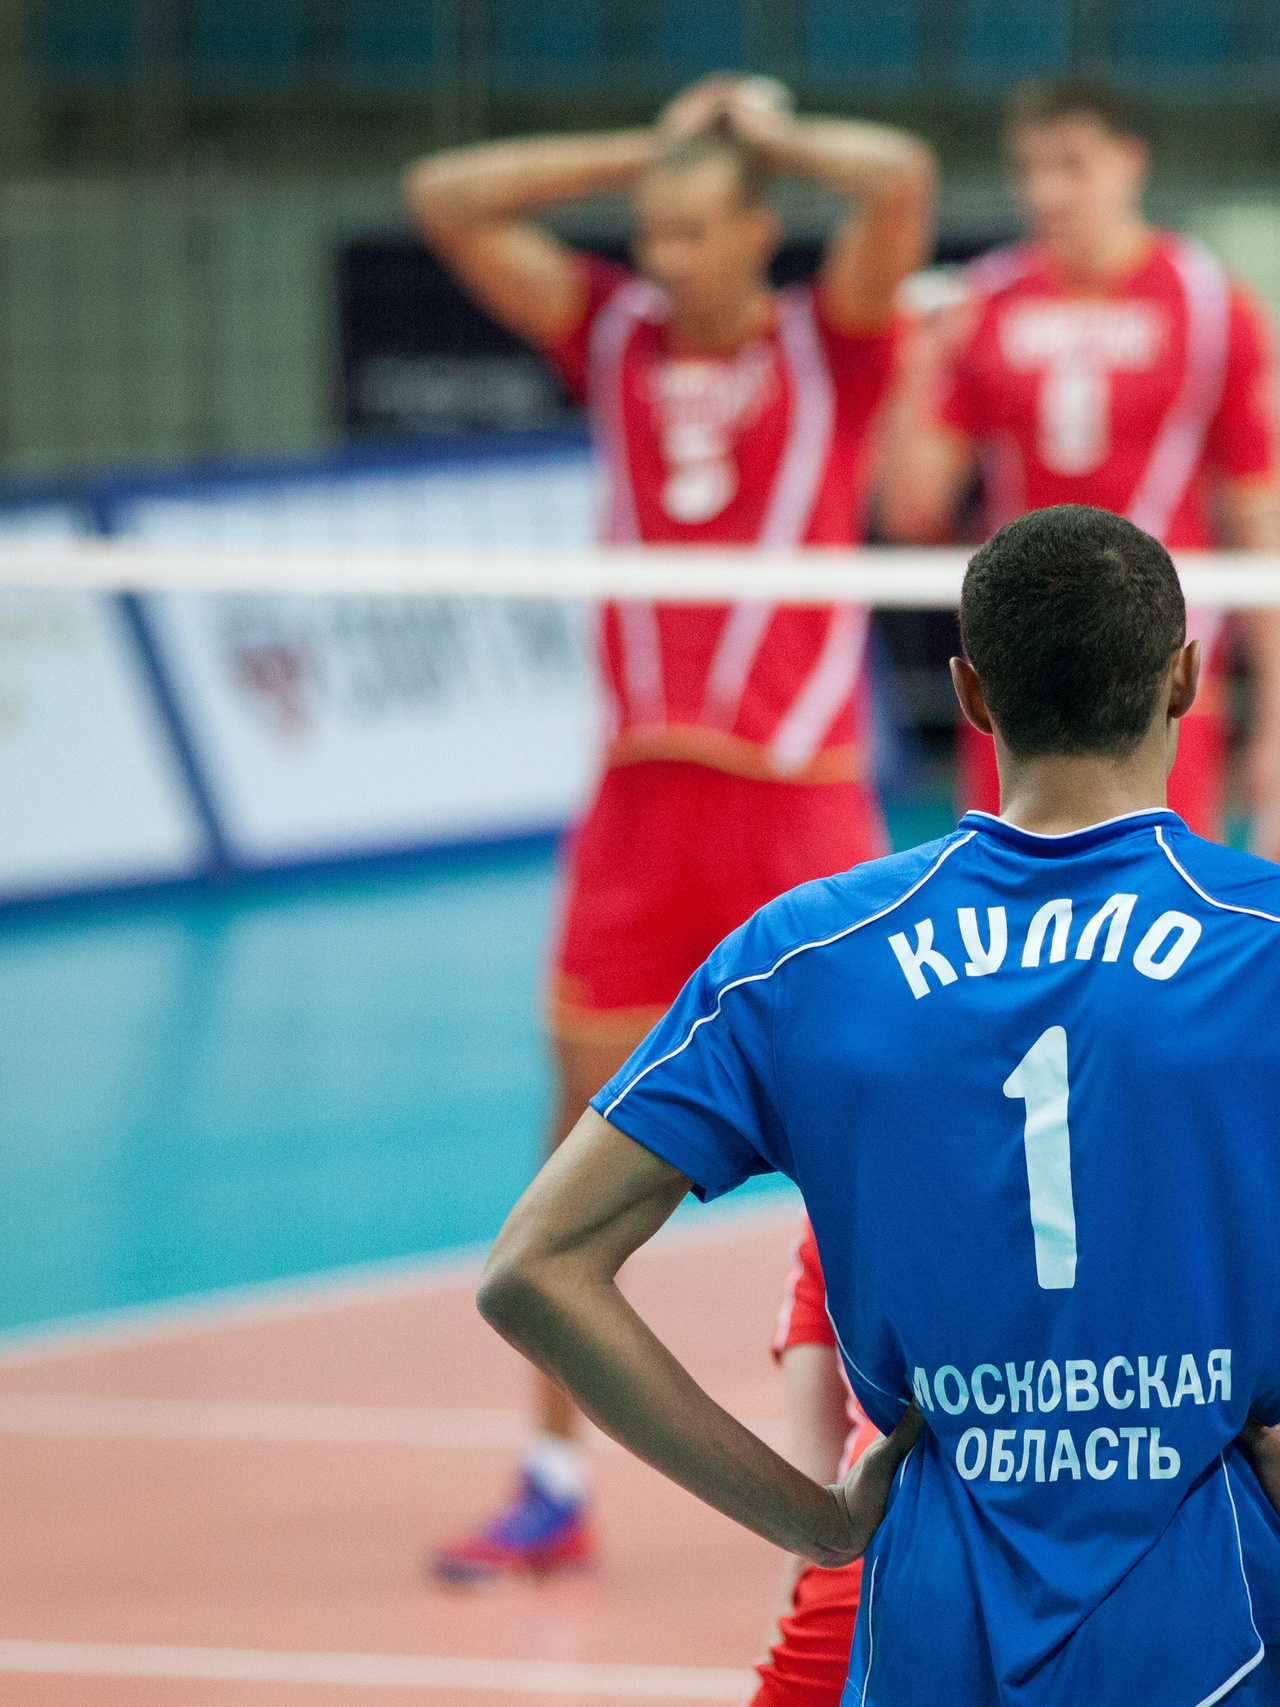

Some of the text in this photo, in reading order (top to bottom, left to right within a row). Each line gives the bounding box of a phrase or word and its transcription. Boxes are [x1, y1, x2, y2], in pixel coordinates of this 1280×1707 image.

[888, 893, 1202, 1000] КУЛЛО
[1002, 1025, 1078, 1290] 1
[955, 1426, 1182, 1483] ОБЛАСТЬ
